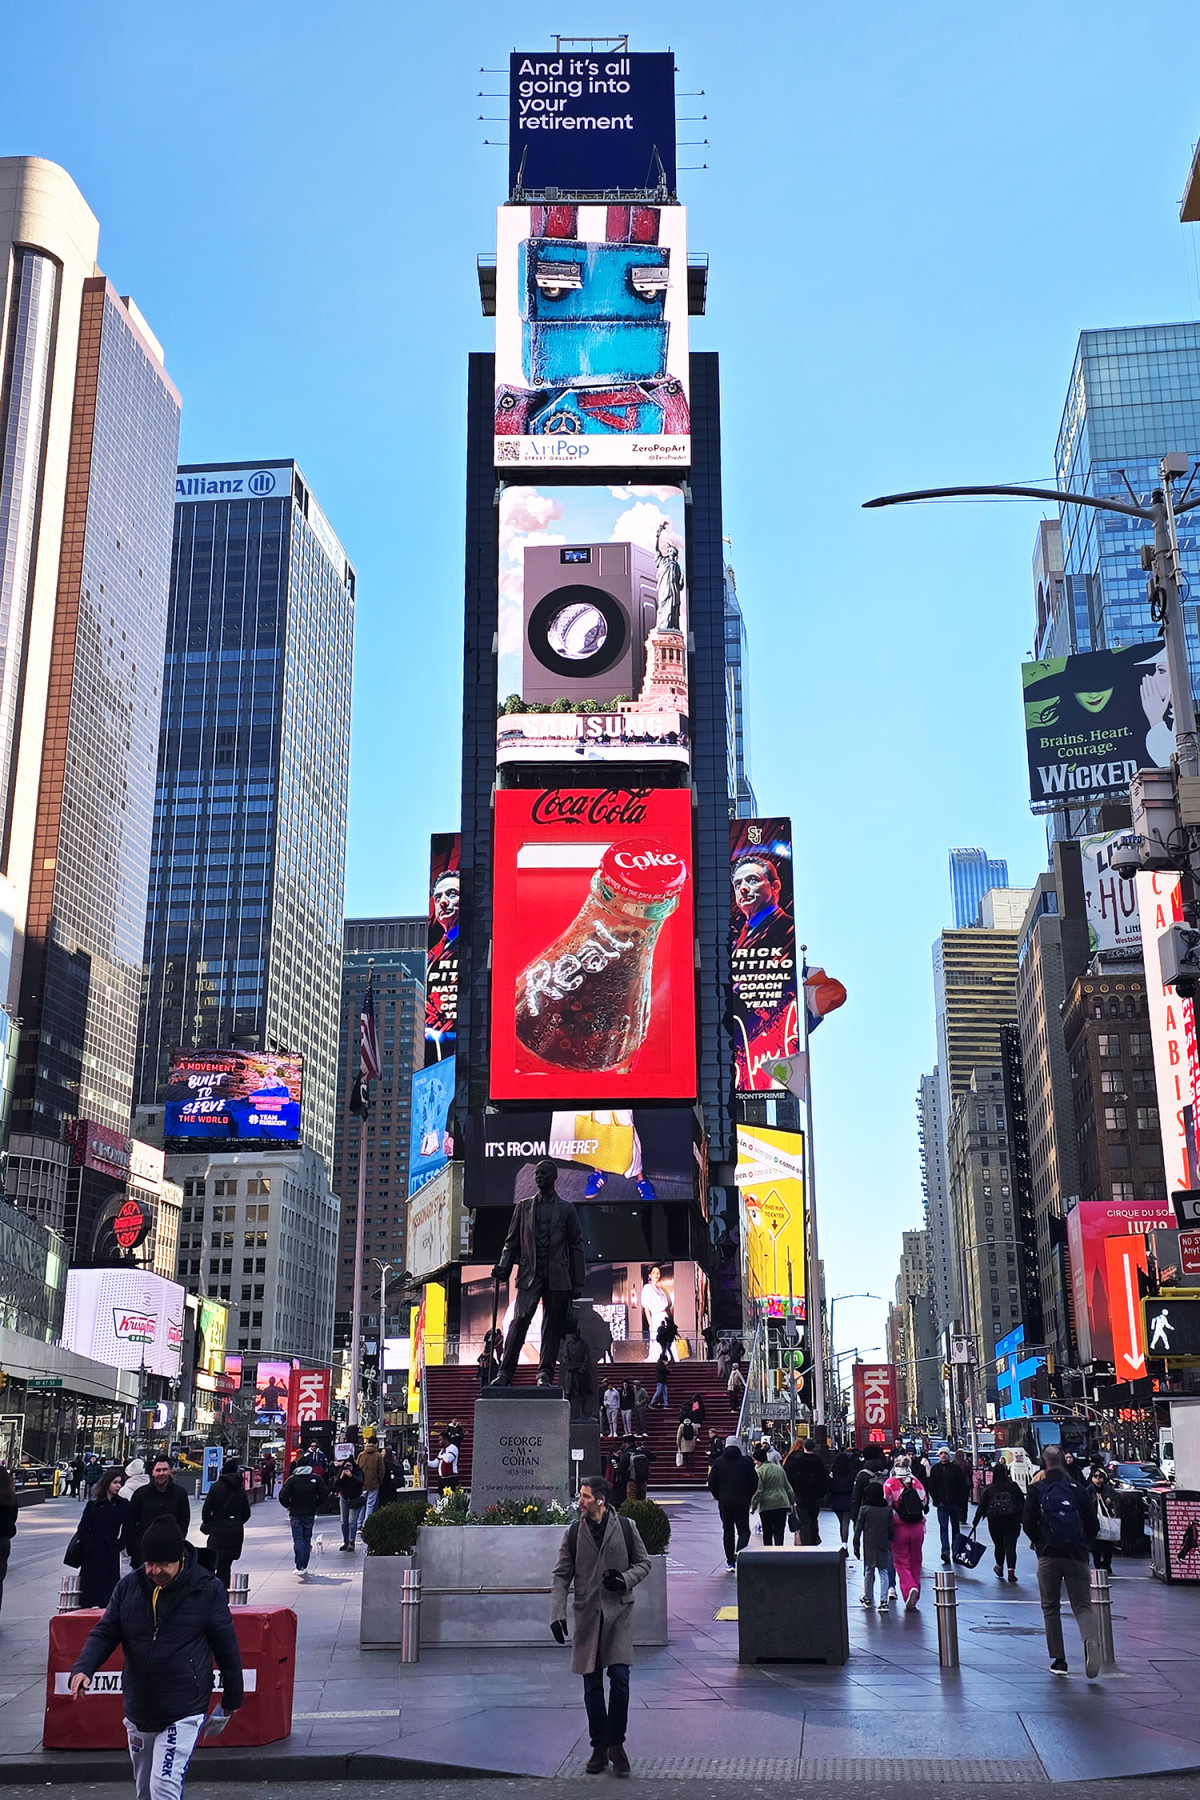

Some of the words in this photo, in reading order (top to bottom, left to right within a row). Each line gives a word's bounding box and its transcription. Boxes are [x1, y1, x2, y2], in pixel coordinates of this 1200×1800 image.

[519, 59, 563, 75] And
[569, 59, 599, 75] it's
[605, 58, 631, 75] all
[519, 77, 583, 97] going
[588, 77, 631, 93] into
[519, 99, 567, 115] your
[519, 112, 633, 129] retirement
[525, 440, 590, 458] ArtPop
[632, 444, 686, 452] ZeroPopArt
[176, 477, 244, 496] Allianz
[523, 715, 664, 738] SAMSUNG
[1040, 733, 1088, 749] Brains.
[1090, 726, 1133, 741] Heart.
[1057, 742, 1117, 758] Courage.
[614, 851, 684, 871] Coke
[736, 947, 783, 958] RICK
[526, 920, 634, 1017] Real
[739, 982, 783, 991] COACH
[739, 991, 755, 1000] OF
[757, 991, 782, 999] THE
[1152, 870, 1186, 1137] CAABIS
[745, 1000, 778, 1009] YEAR
[187, 1063, 237, 1071] MOVEMENT
[188, 1073, 228, 1089] BUILT
[198, 1087, 212, 1099] TO
[182, 1099, 227, 1115] SERVE
[179, 1115, 196, 1123] THE
[198, 1115, 229, 1124] WORLD
[485, 1142, 504, 1157] IT'S
[507, 1141, 546, 1156] FROM
[548, 1139, 599, 1154] WHERE?
[1107, 1209, 1140, 1219] CIRQUE
[1182, 1237, 1192, 1245] NO
[298, 1373, 324, 1427] tkts
[863, 1368, 889, 1425] tkts
[500, 1436, 543, 1447] GEORGE
[502, 1456, 540, 1466] COHAN
[162, 1747, 176, 1778] YORK
